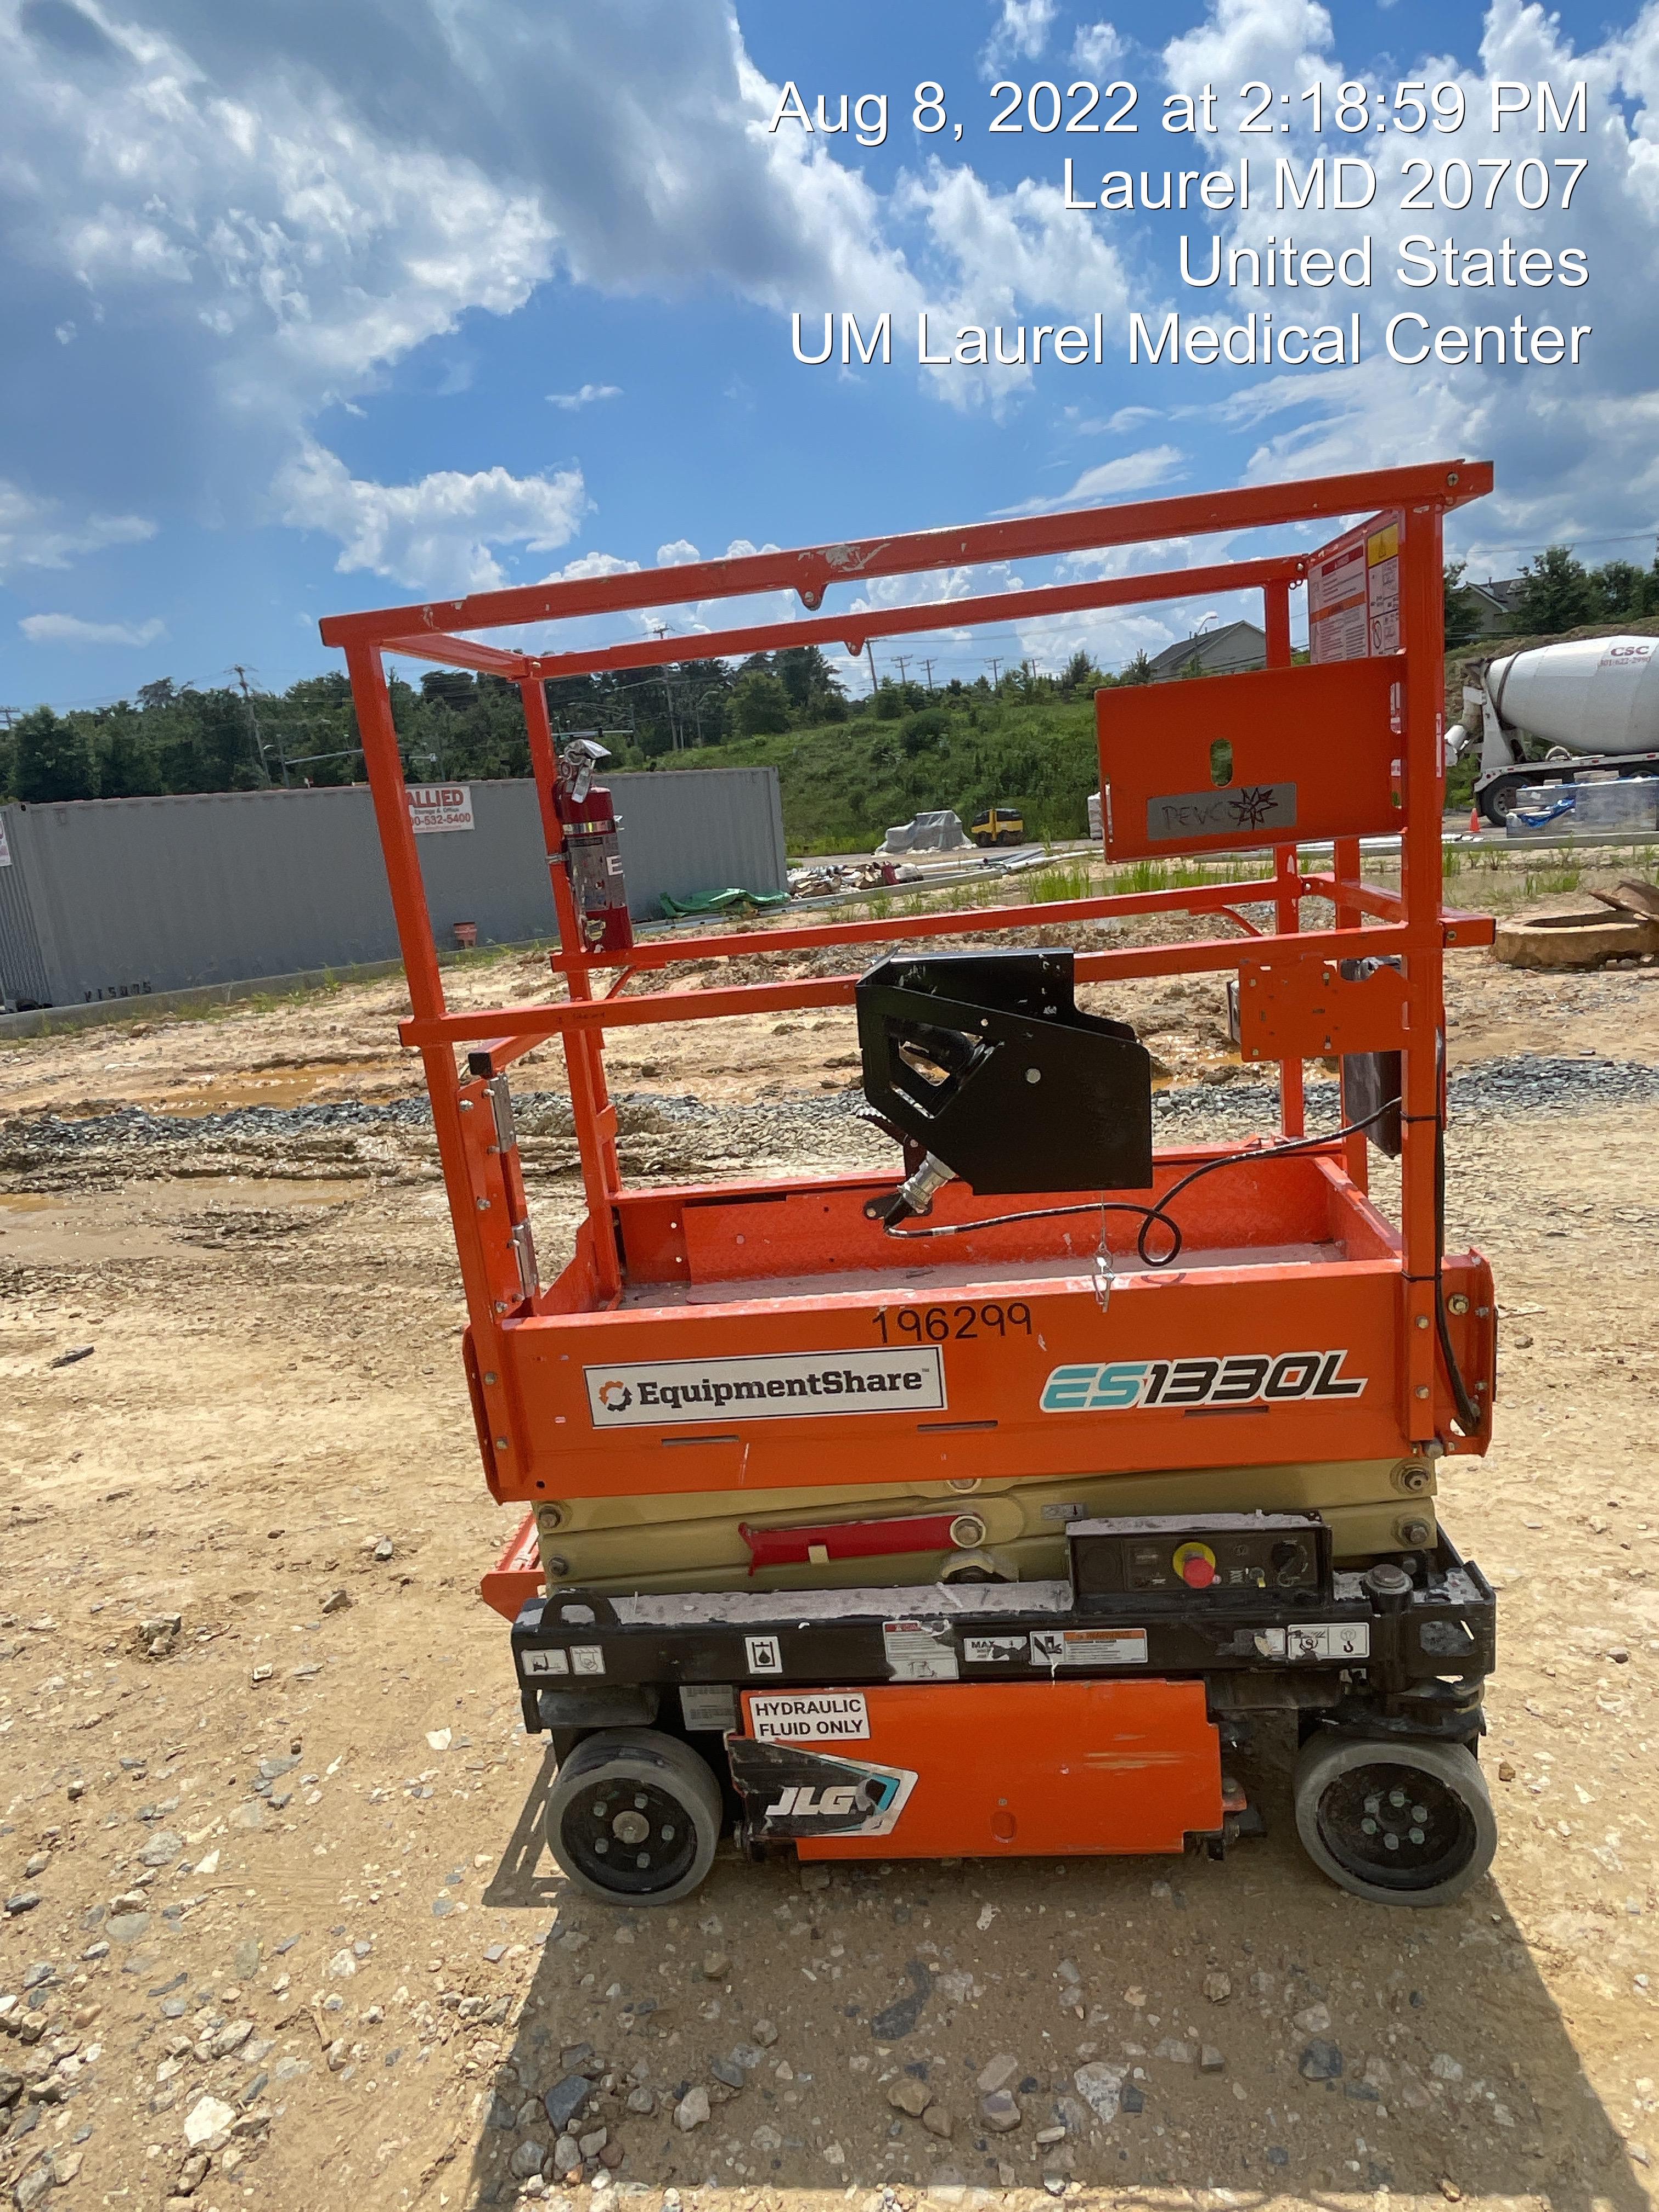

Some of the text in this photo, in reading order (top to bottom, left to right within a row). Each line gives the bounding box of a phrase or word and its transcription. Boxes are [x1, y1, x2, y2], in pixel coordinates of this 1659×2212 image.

[1611, 646, 1649, 656] CSC
[407, 789, 464, 808] ALLIED
[873, 1302, 1032, 1344] 196299
[637, 1370, 923, 1410] EquipmentShare
[1040, 1349, 1368, 1412] ES1330L
[755, 1700, 861, 1716] HYDRAULIC
[760, 1720, 863, 1736] FLUID ONLY
[765, 1786, 857, 1815] JLG
